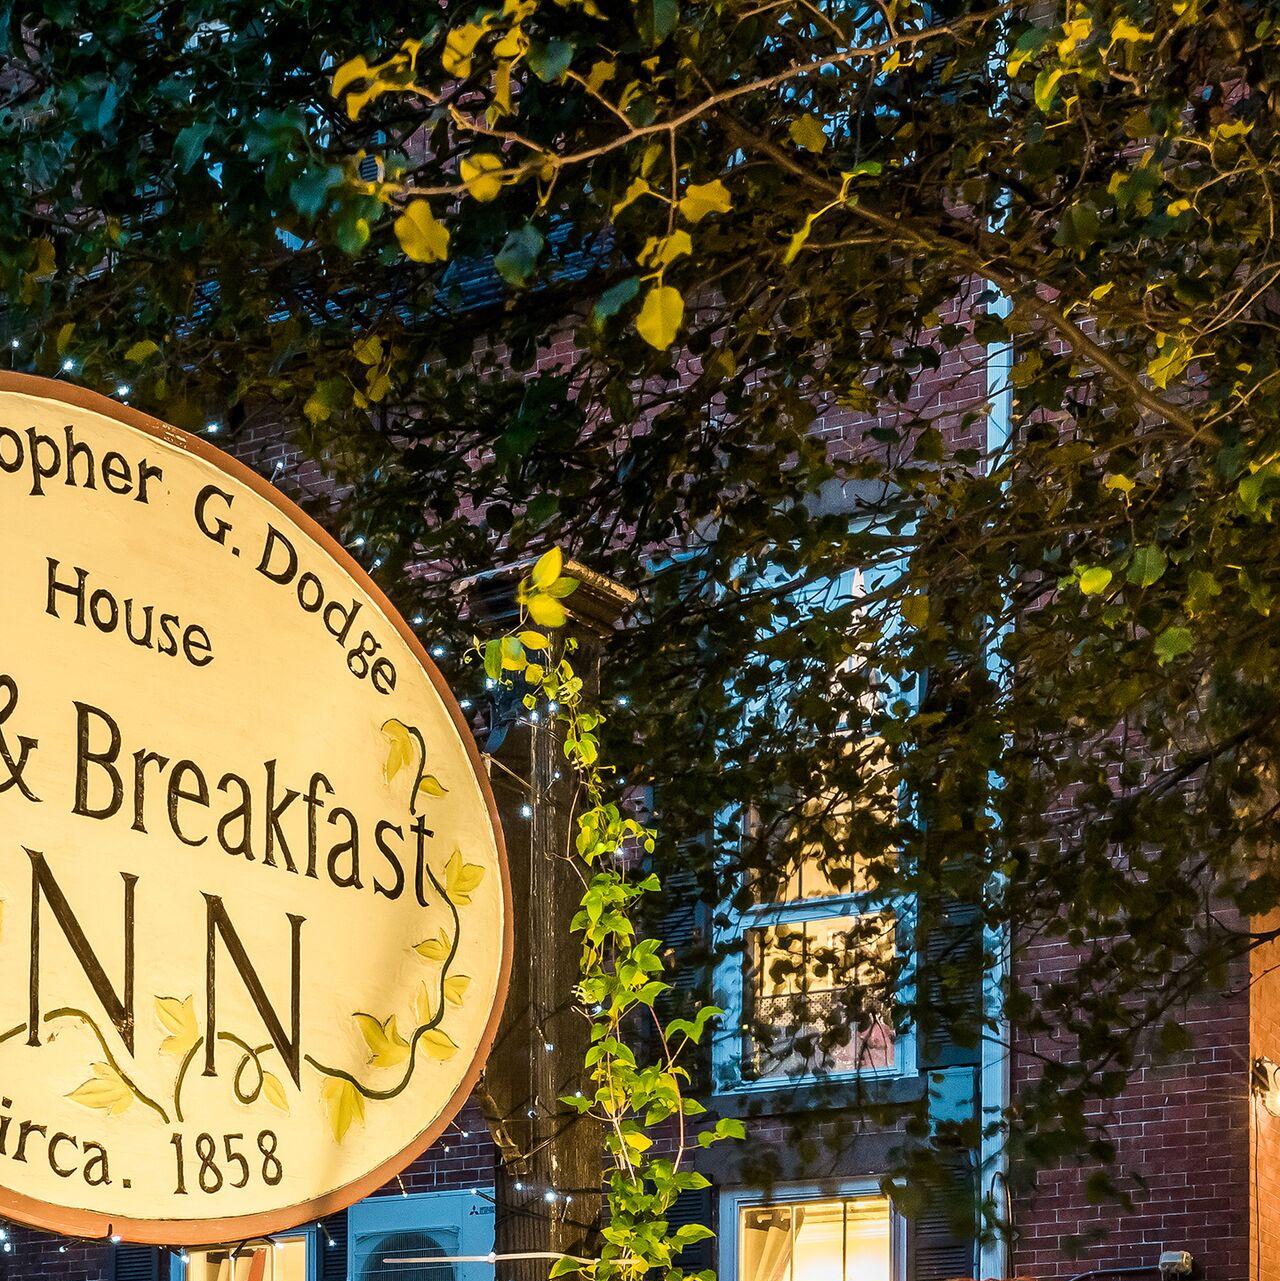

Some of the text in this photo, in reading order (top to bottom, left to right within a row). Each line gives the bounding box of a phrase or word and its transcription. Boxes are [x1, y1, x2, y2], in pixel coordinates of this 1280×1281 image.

[45, 556, 215, 667] House
[194, 484, 242, 557] G.
[255, 522, 397, 695] Dodge
[71, 700, 435, 908] Breakfast
[169, 1129, 283, 1195] 1858
